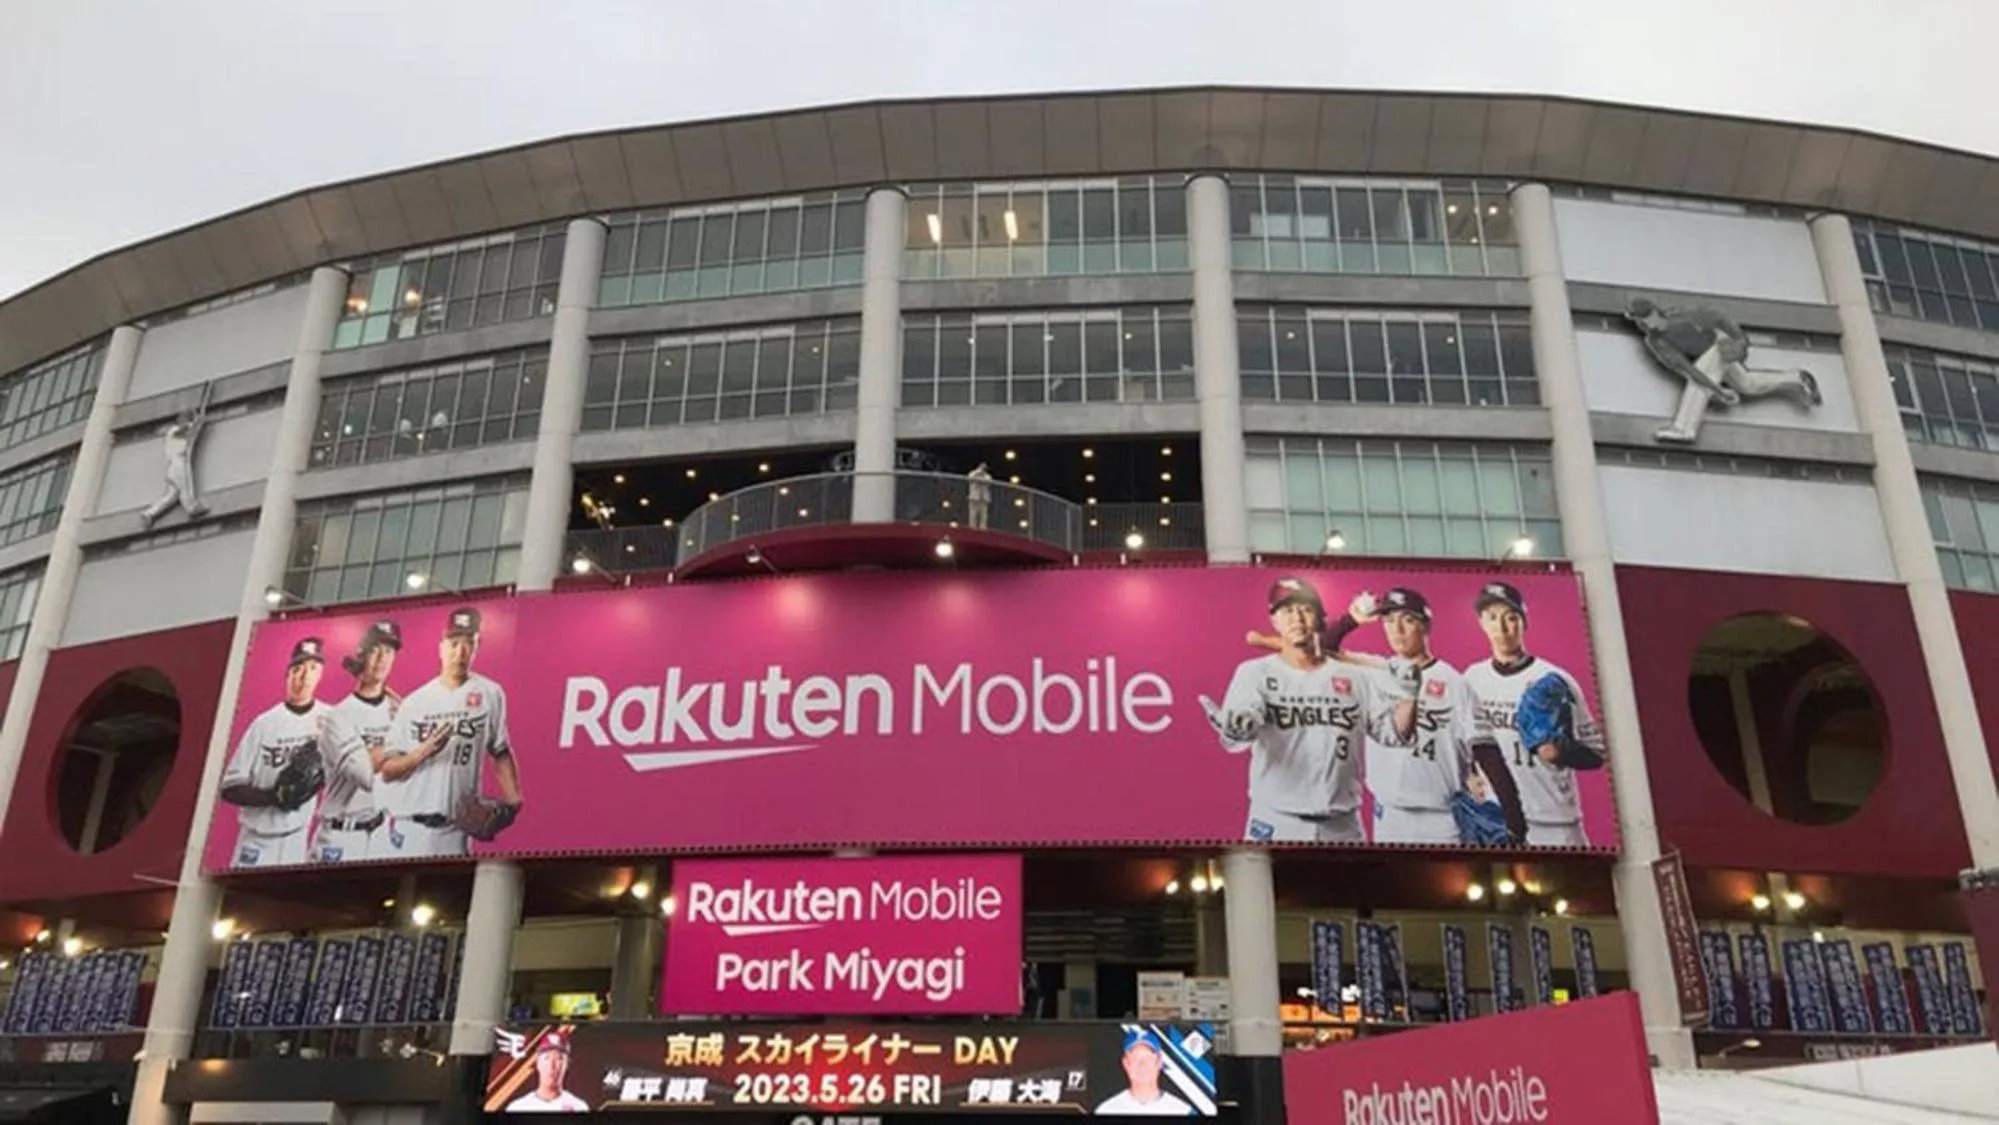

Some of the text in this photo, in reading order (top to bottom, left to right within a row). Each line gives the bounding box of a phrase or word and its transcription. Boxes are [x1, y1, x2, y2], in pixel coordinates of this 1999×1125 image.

[559, 657, 1173, 748] Rakuten Mobile
[1265, 702, 1359, 730] EAGLES
[452, 743, 473, 766] 18
[1335, 735, 1349, 761] 3
[687, 878, 1002, 923] Rakuten Mobile
[716, 947, 965, 1001] Park Miyagi
[664, 1033, 1019, 1067] 京成 スカイライナー DAY
[733, 1073, 941, 1105] 2023.5.26 FRI
[1343, 1065, 1548, 1125] Rakuten Mobile
